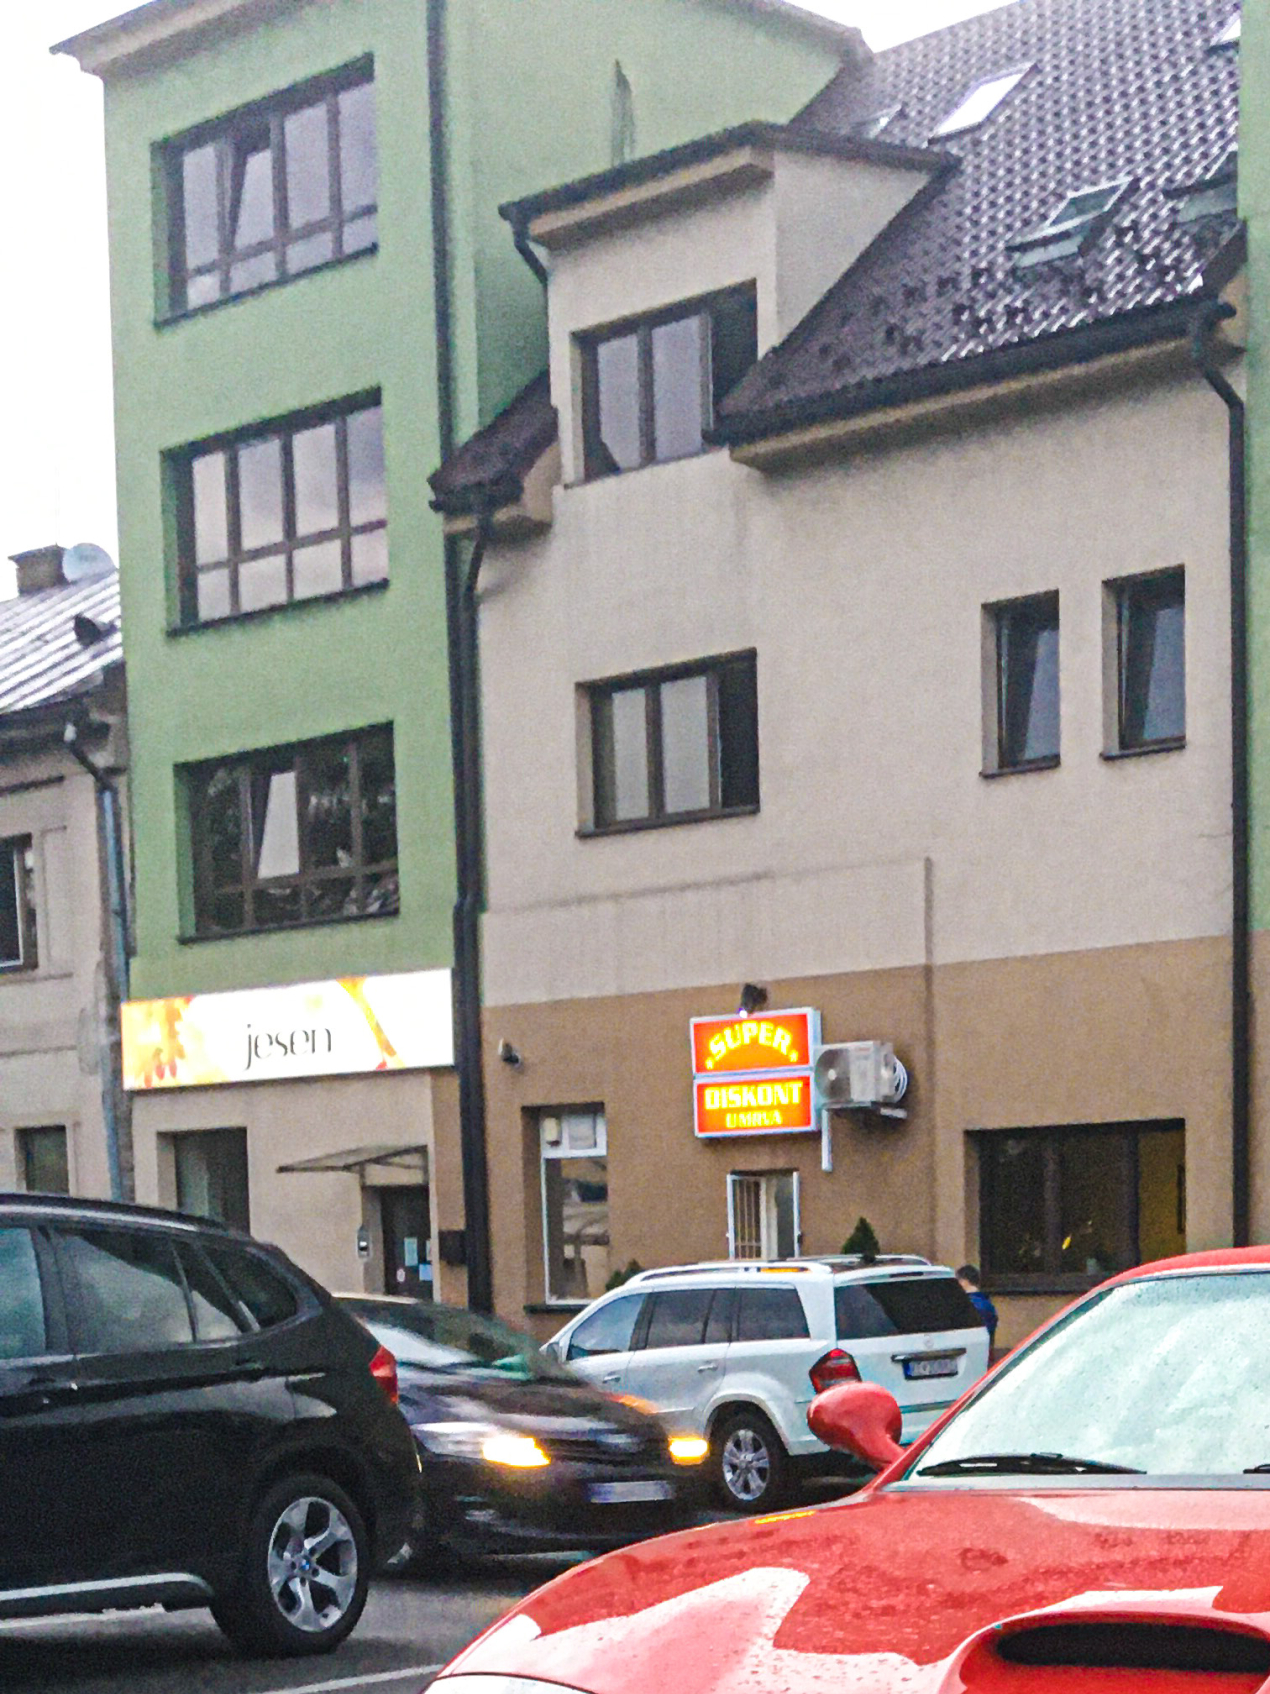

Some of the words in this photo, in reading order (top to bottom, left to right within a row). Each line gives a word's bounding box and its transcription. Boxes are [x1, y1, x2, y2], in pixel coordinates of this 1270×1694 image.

[243, 1023, 332, 1072] jesen
[708, 1020, 792, 1062] SUPER
[703, 1081, 804, 1111] DISKONT
